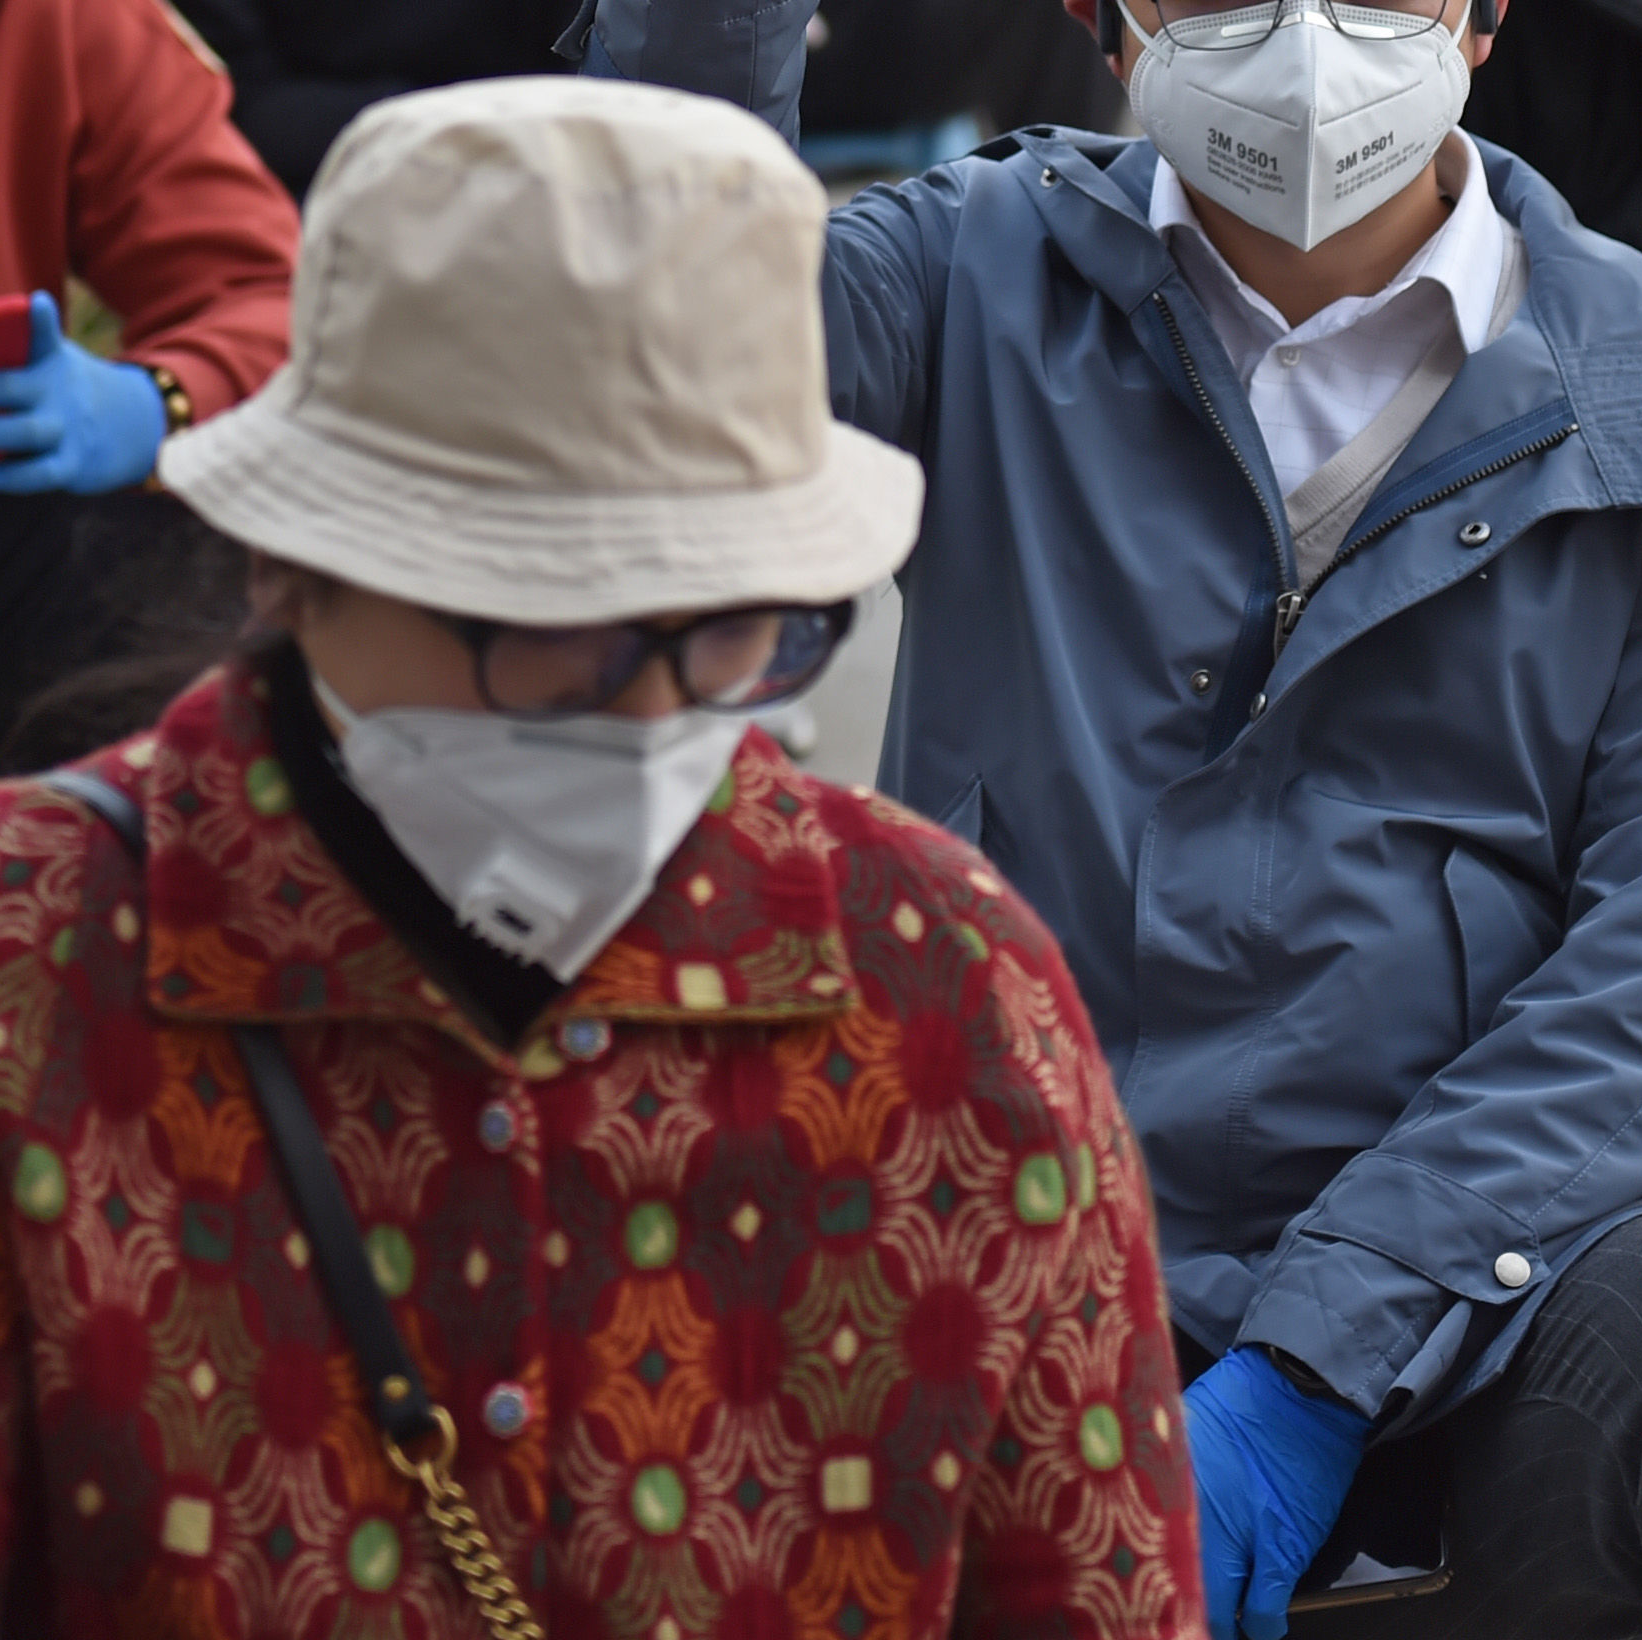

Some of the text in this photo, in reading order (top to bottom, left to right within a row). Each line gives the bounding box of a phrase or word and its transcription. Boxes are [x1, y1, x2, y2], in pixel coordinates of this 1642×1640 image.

[1207, 128, 1278, 172] 3M 9501
[1336, 151, 1358, 175] 3M
[1362, 130, 1394, 161] 9501
